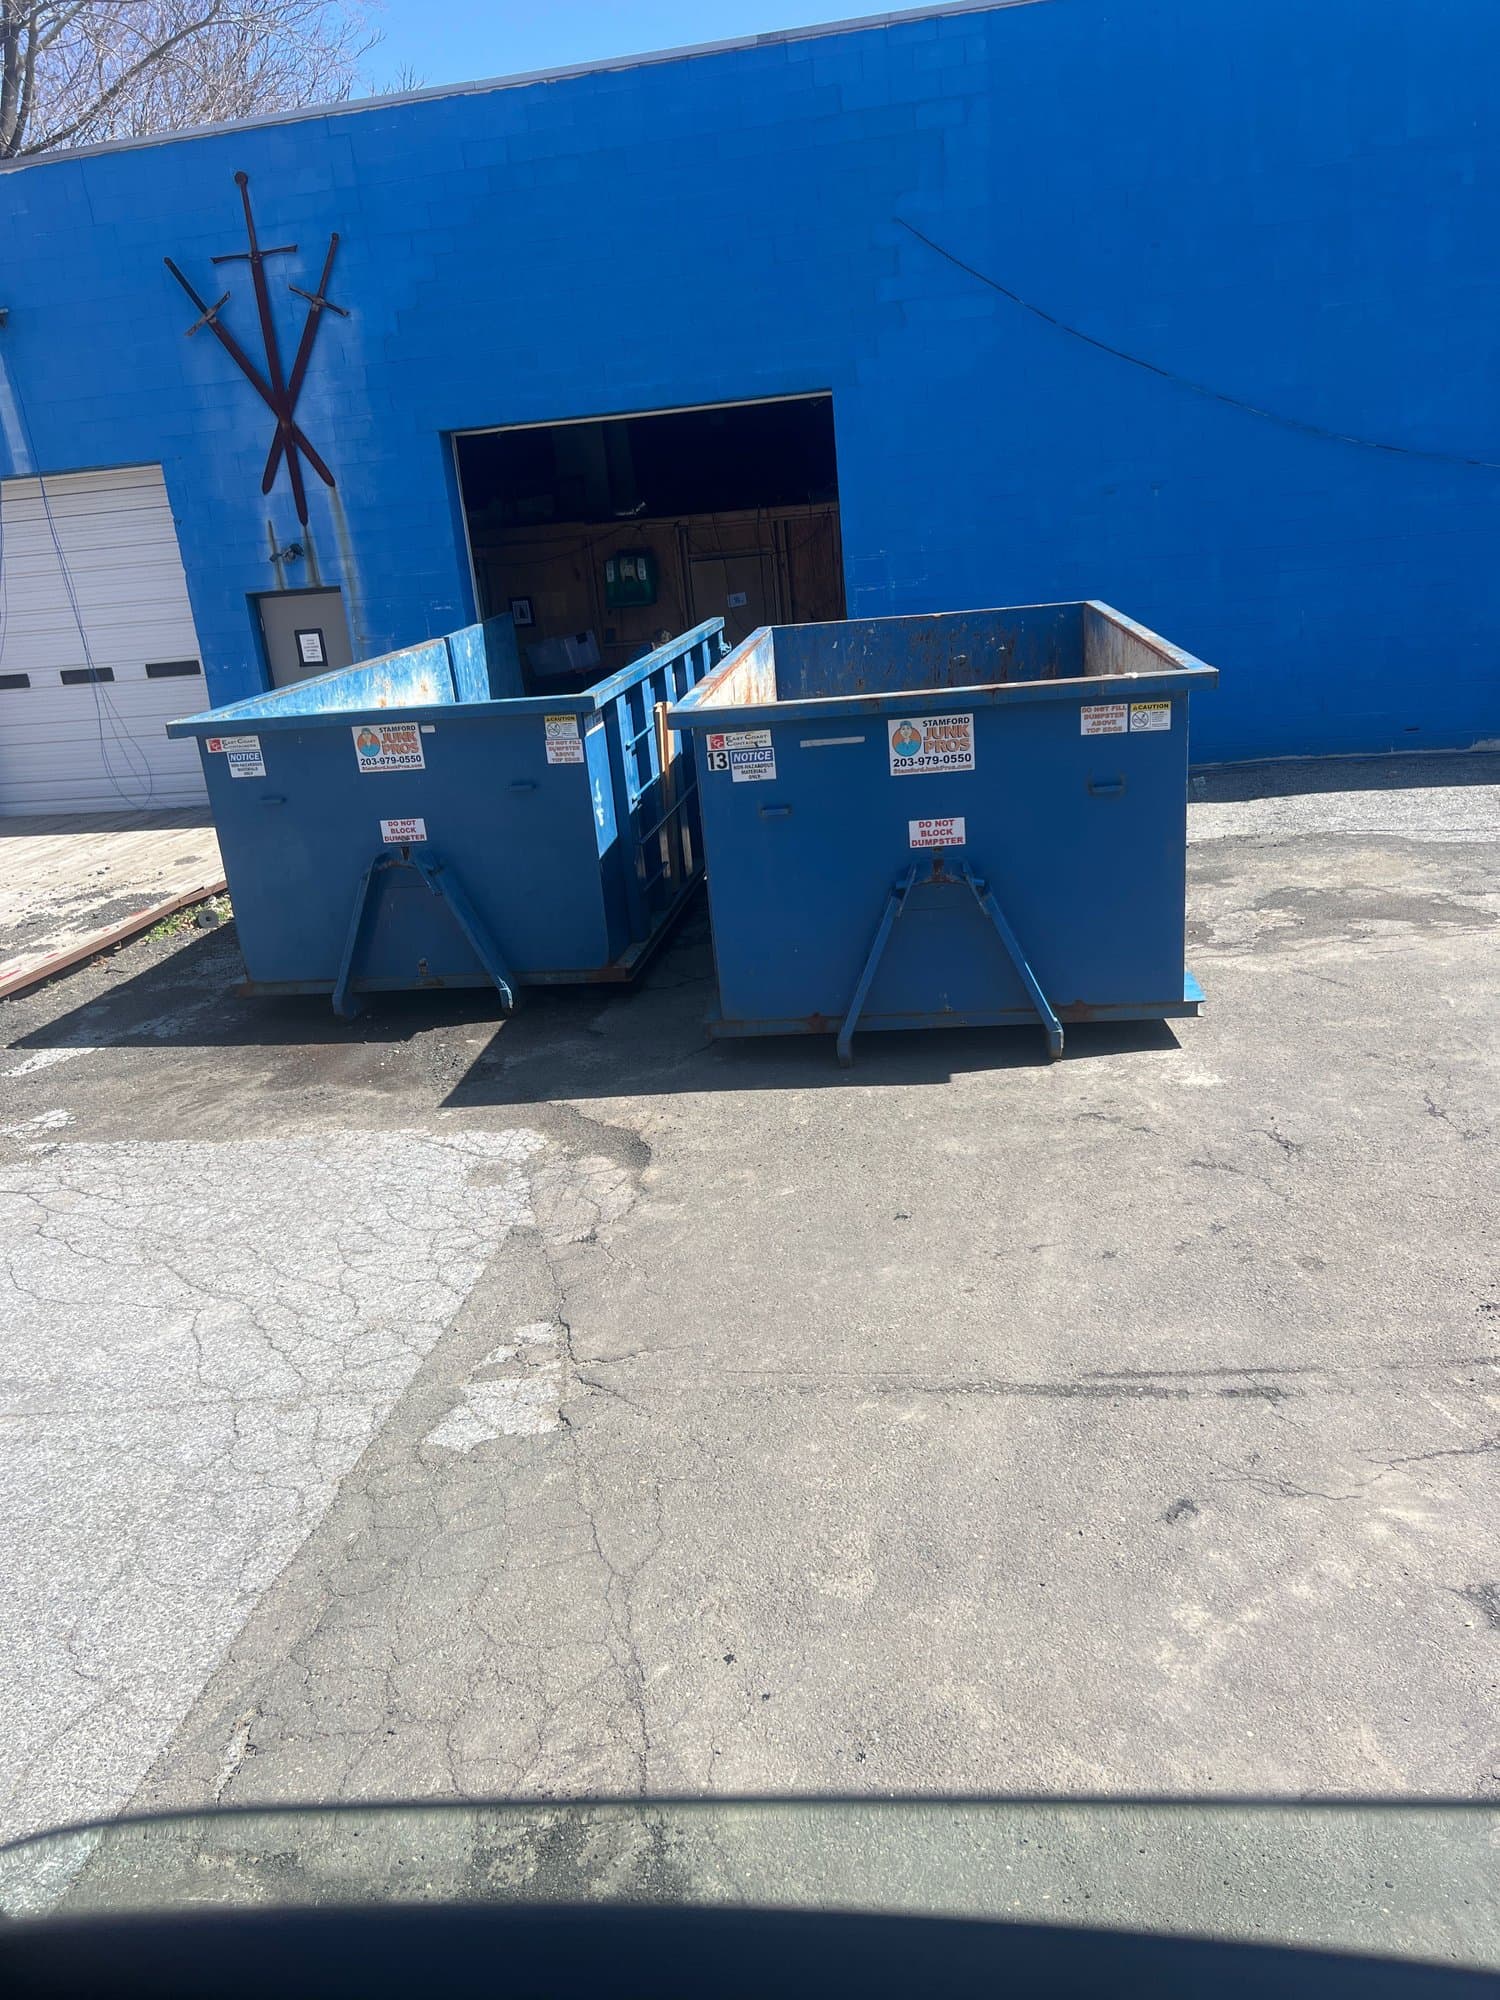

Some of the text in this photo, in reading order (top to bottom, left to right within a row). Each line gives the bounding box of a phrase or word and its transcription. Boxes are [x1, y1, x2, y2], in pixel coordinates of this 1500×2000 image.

[1084, 712, 1124, 720] DUMPSTER
[923, 717, 969, 727] STAMFORD
[379, 725, 415, 733] STAMFORD
[923, 724, 970, 740] JUNK
[383, 732, 417, 743] JUNK
[382, 742, 419, 755] PROS
[923, 738, 971, 754] PROS
[230, 753, 260, 761] NOTICE
[361, 755, 421, 765] 203-979-0550
[708, 753, 727, 769] 13
[734, 751, 771, 762] NOTICE
[893, 753, 971, 768] 203-979-0550
[935, 819, 955, 827] NOT
[921, 829, 953, 837] BLOCK
[912, 837, 963, 846] DUMPSTER
